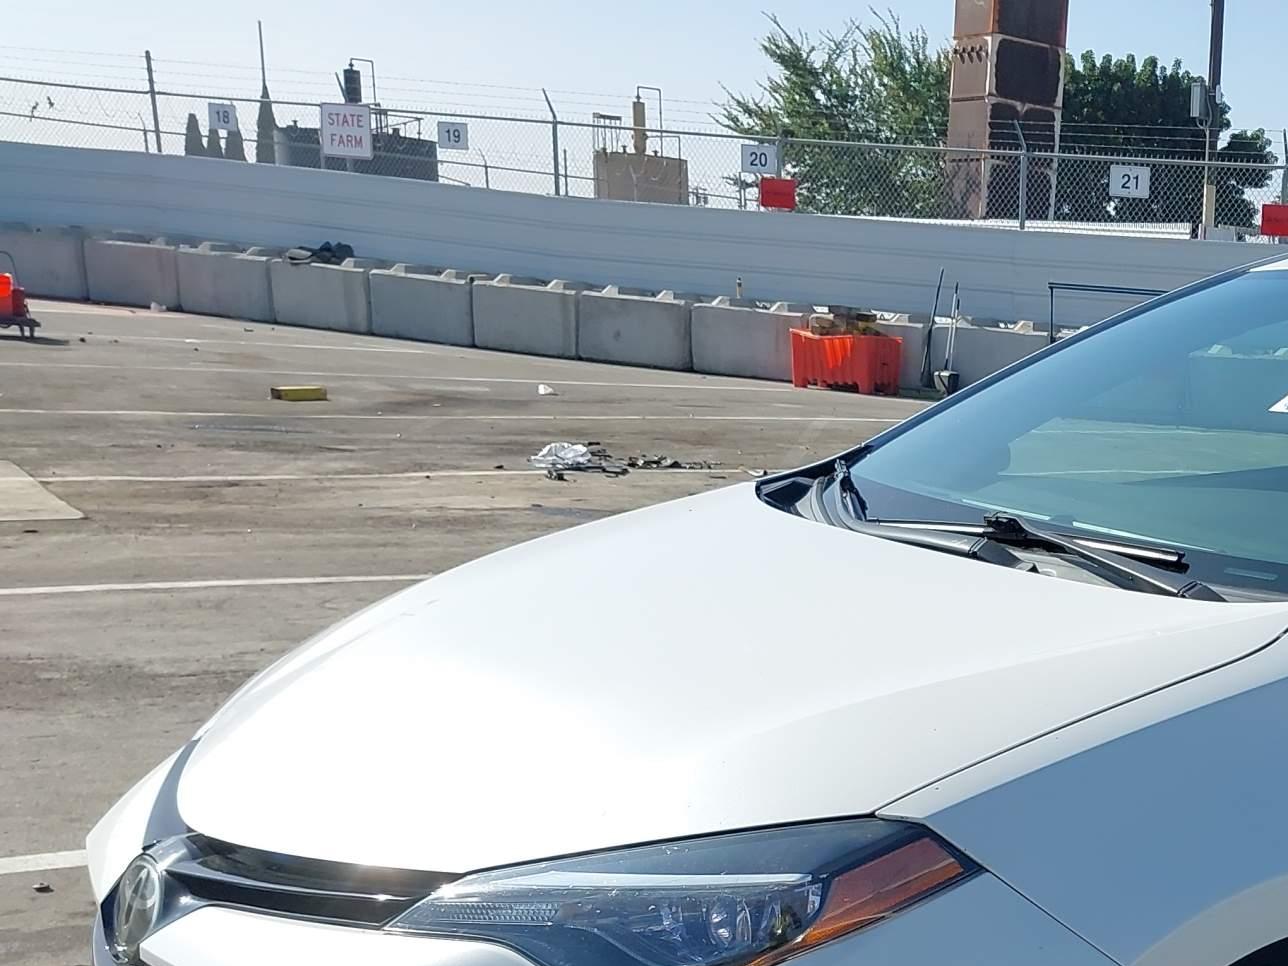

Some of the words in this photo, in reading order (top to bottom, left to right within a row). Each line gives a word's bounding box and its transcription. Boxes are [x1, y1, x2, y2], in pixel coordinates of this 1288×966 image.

[215, 110, 230, 124] 18
[327, 112, 364, 128] STATE
[330, 133, 364, 149] FARM
[445, 129, 461, 143] 19
[750, 151, 768, 167] 20
[1121, 173, 1140, 190] 21
